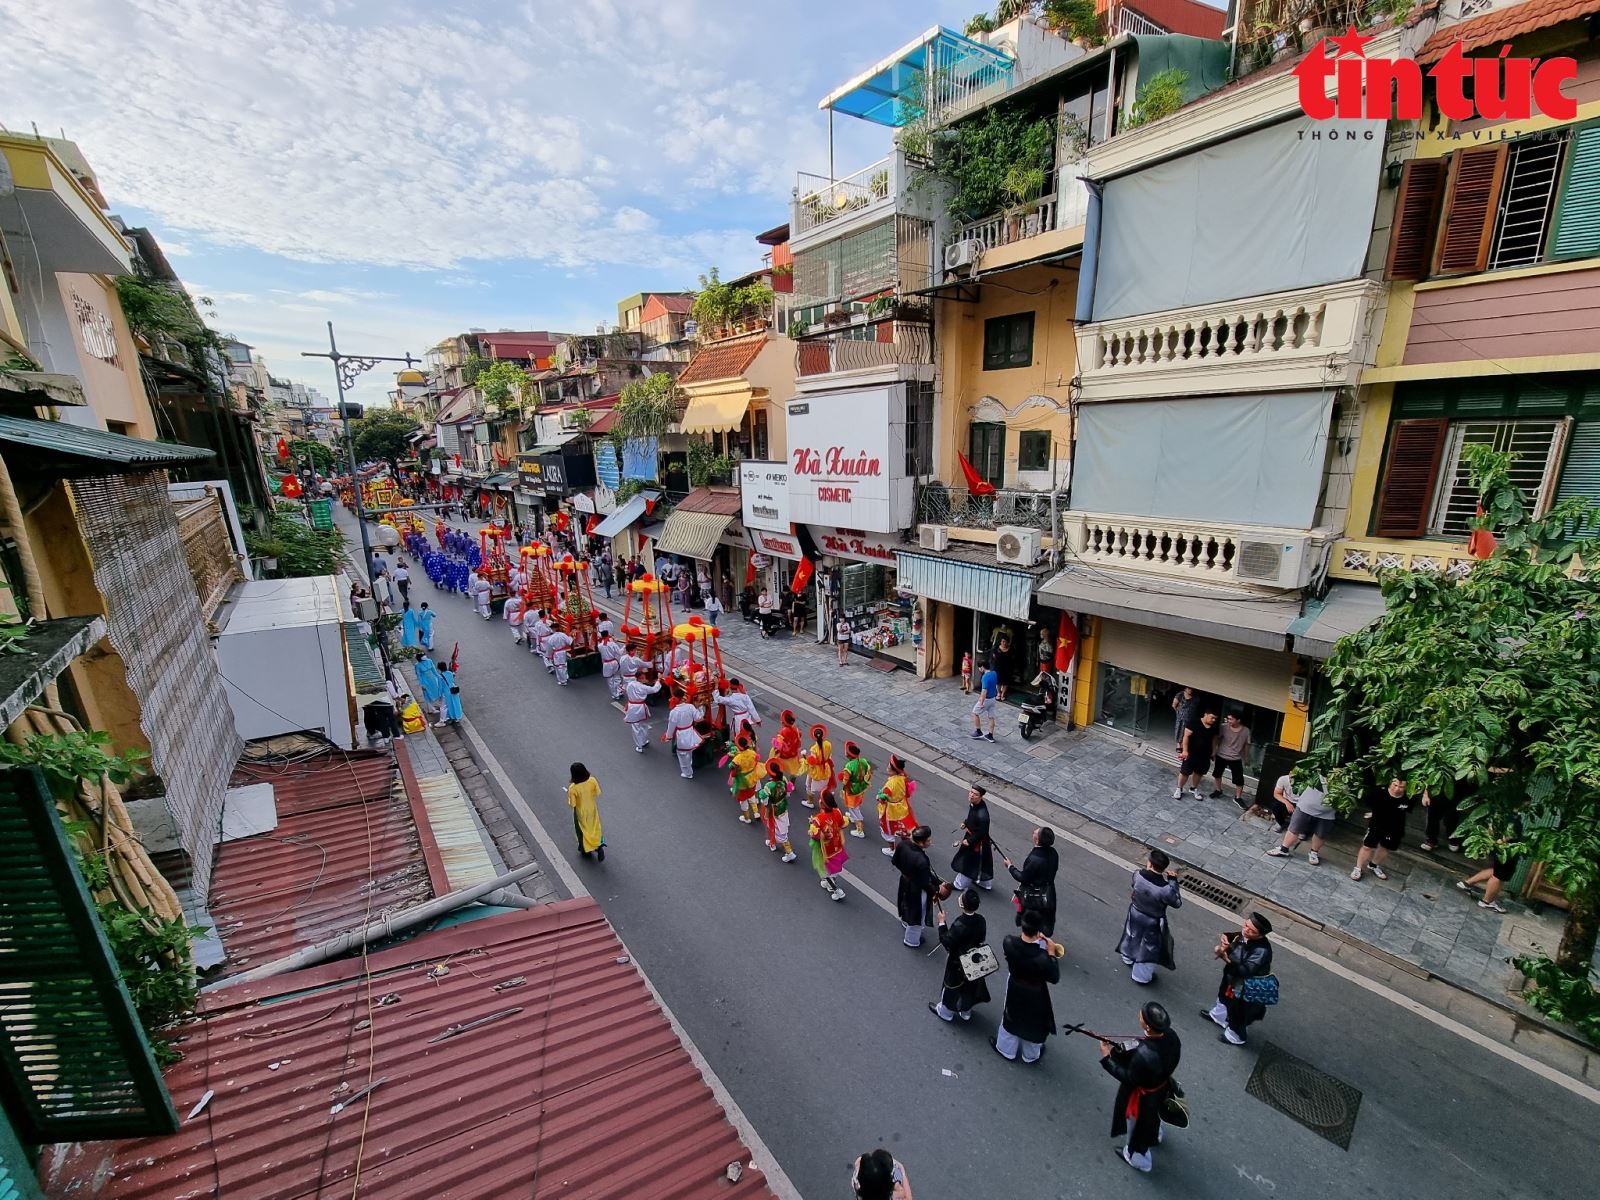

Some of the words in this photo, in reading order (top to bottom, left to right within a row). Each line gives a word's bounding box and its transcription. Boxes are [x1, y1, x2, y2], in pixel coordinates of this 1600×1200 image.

[793, 447, 821, 476] Hà
[825, 446, 881, 477] Xuân
[818, 486, 852, 504] COSMETIC
